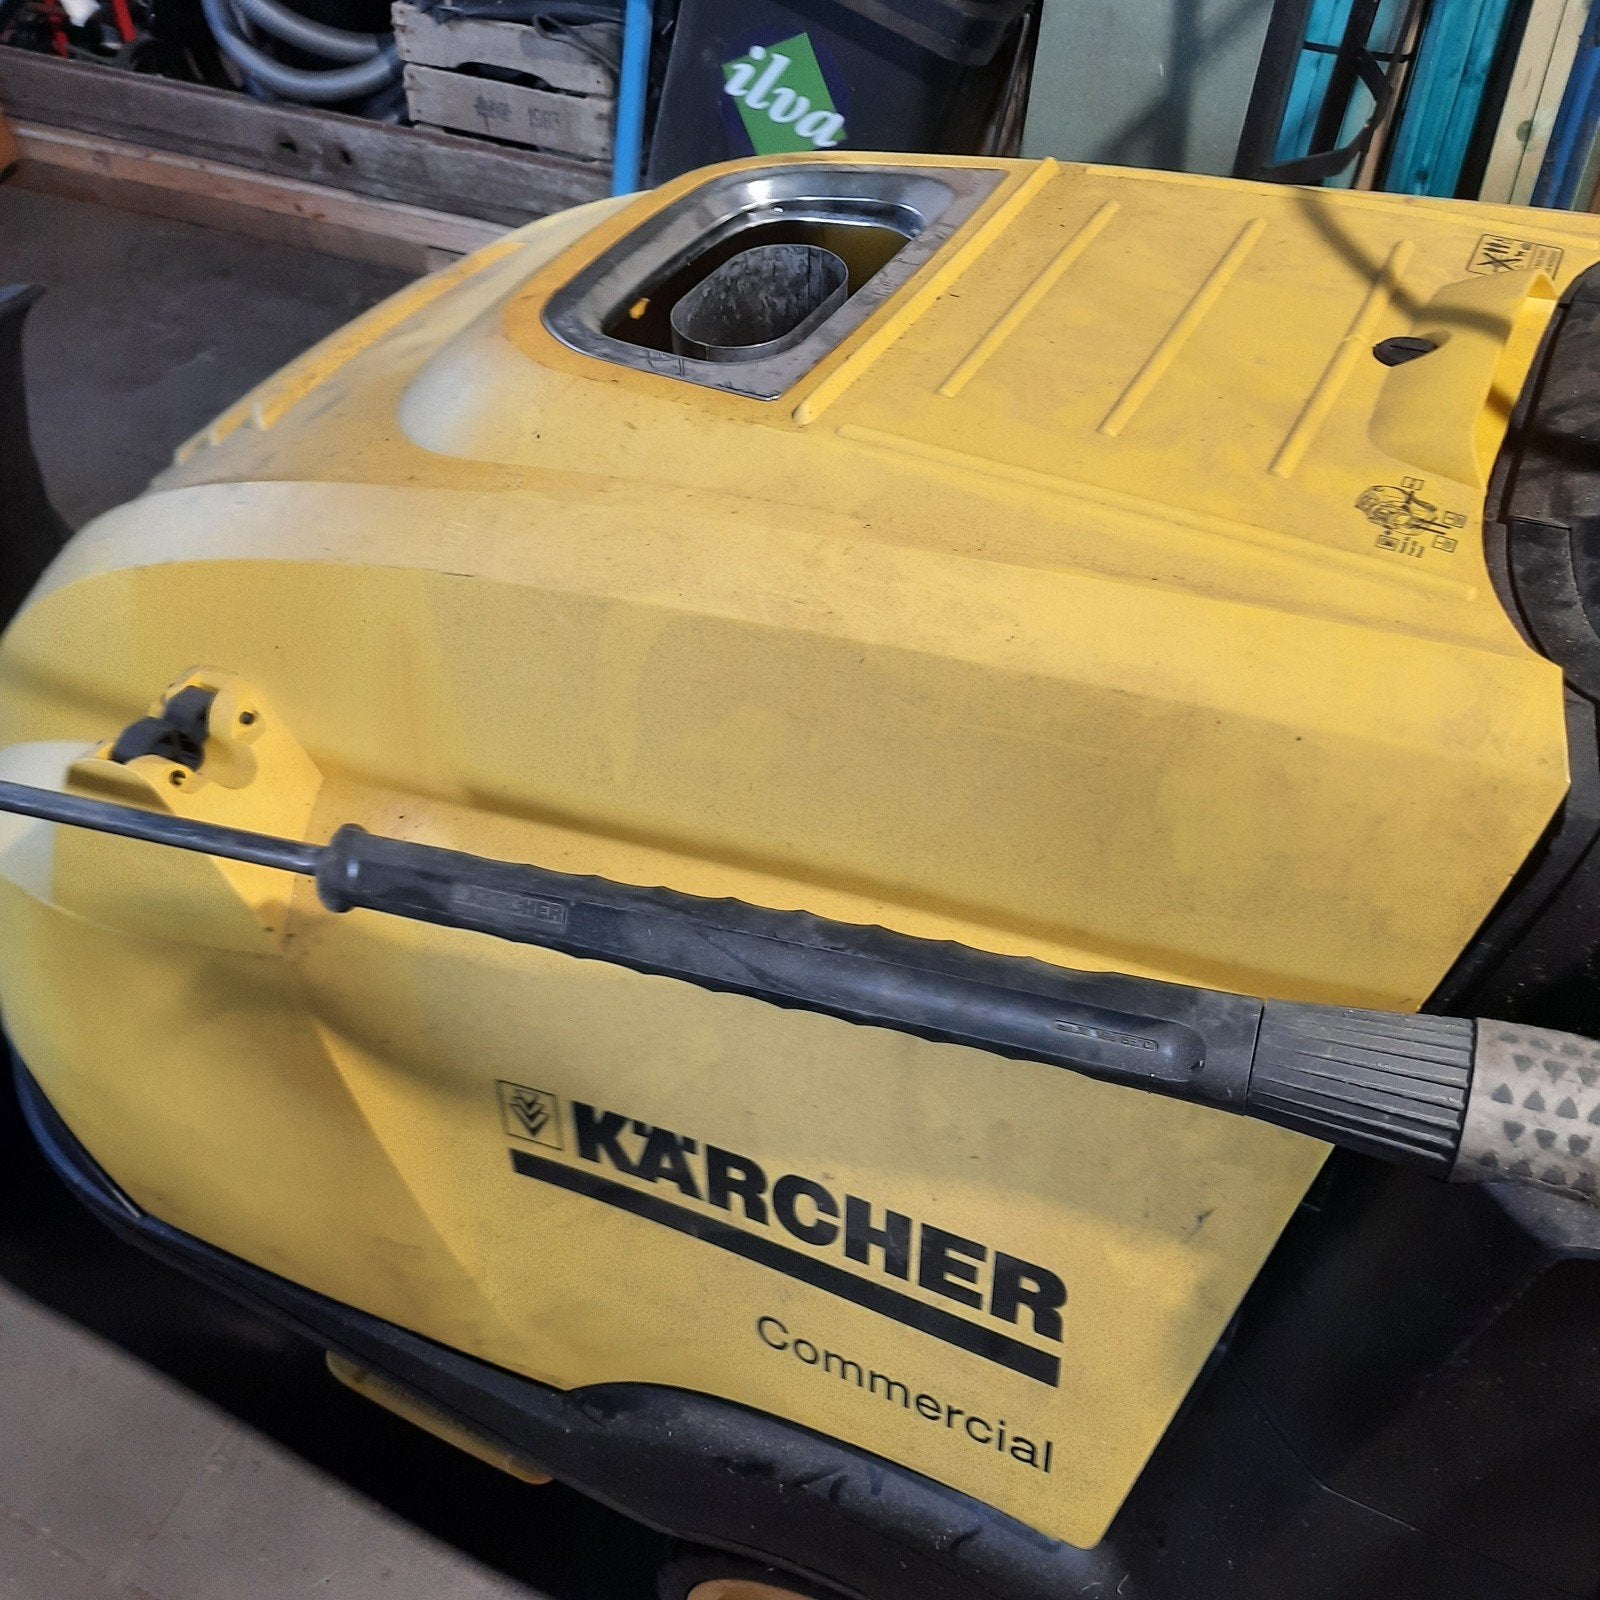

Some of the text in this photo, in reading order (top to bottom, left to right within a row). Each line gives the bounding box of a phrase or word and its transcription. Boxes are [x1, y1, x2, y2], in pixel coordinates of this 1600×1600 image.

[724, 45, 845, 147] ilva
[573, 1101, 1068, 1343] KÄRCHER
[757, 1315, 1053, 1473] Commercial
